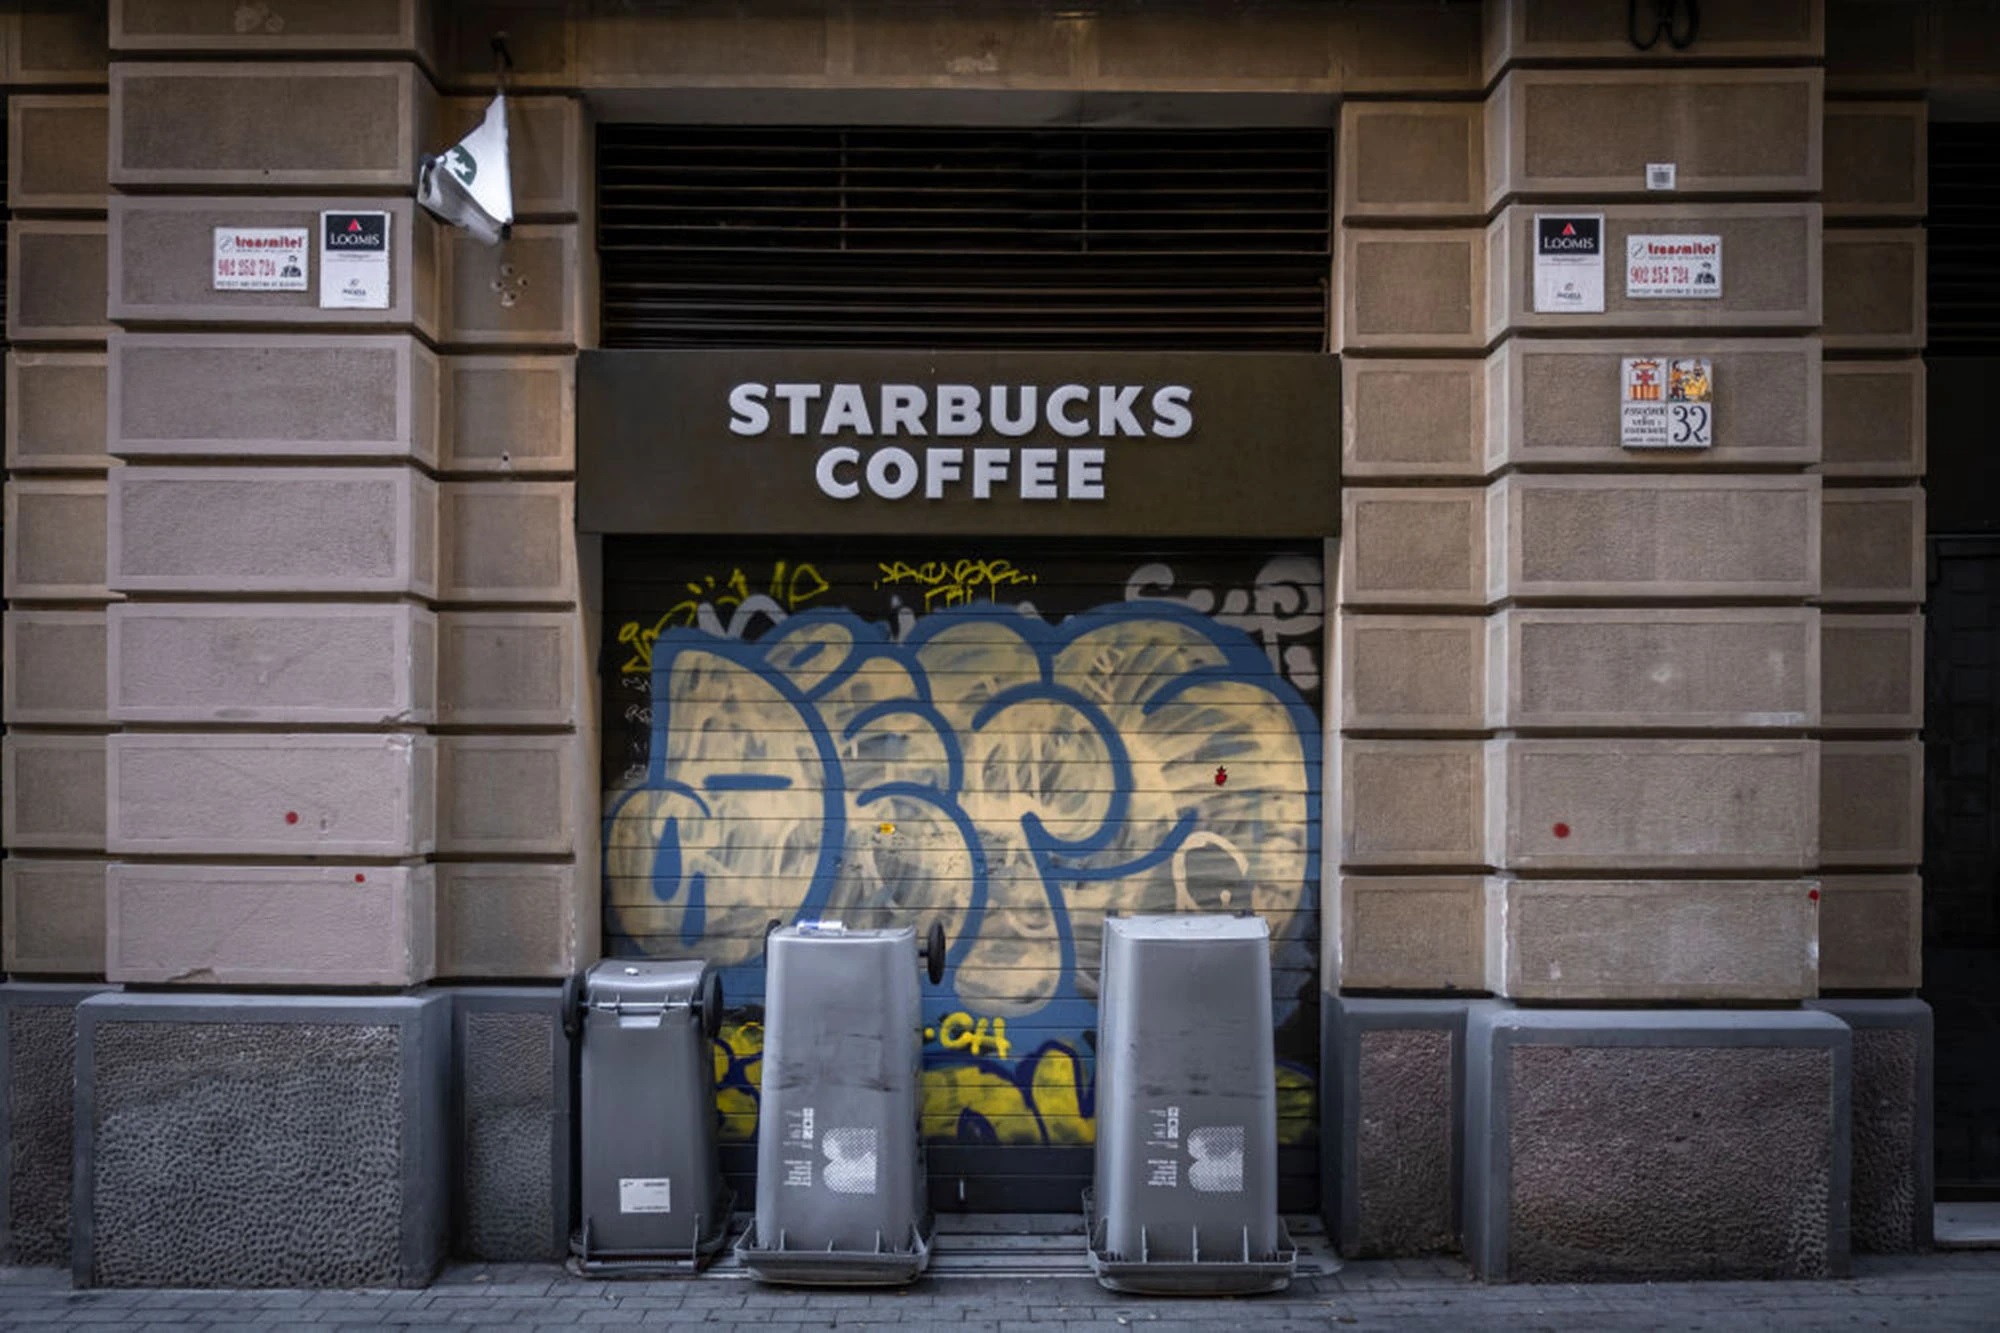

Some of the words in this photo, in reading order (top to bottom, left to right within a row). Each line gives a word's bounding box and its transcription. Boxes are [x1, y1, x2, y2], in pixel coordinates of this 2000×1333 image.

[330, 232, 380, 246] LOOMIS
[1543, 236, 1596, 249] LOOMIS
[728, 383, 1194, 438] STARBUCKS
[1673, 405, 1709, 442] 32
[816, 446, 1106, 499] COFFEE
